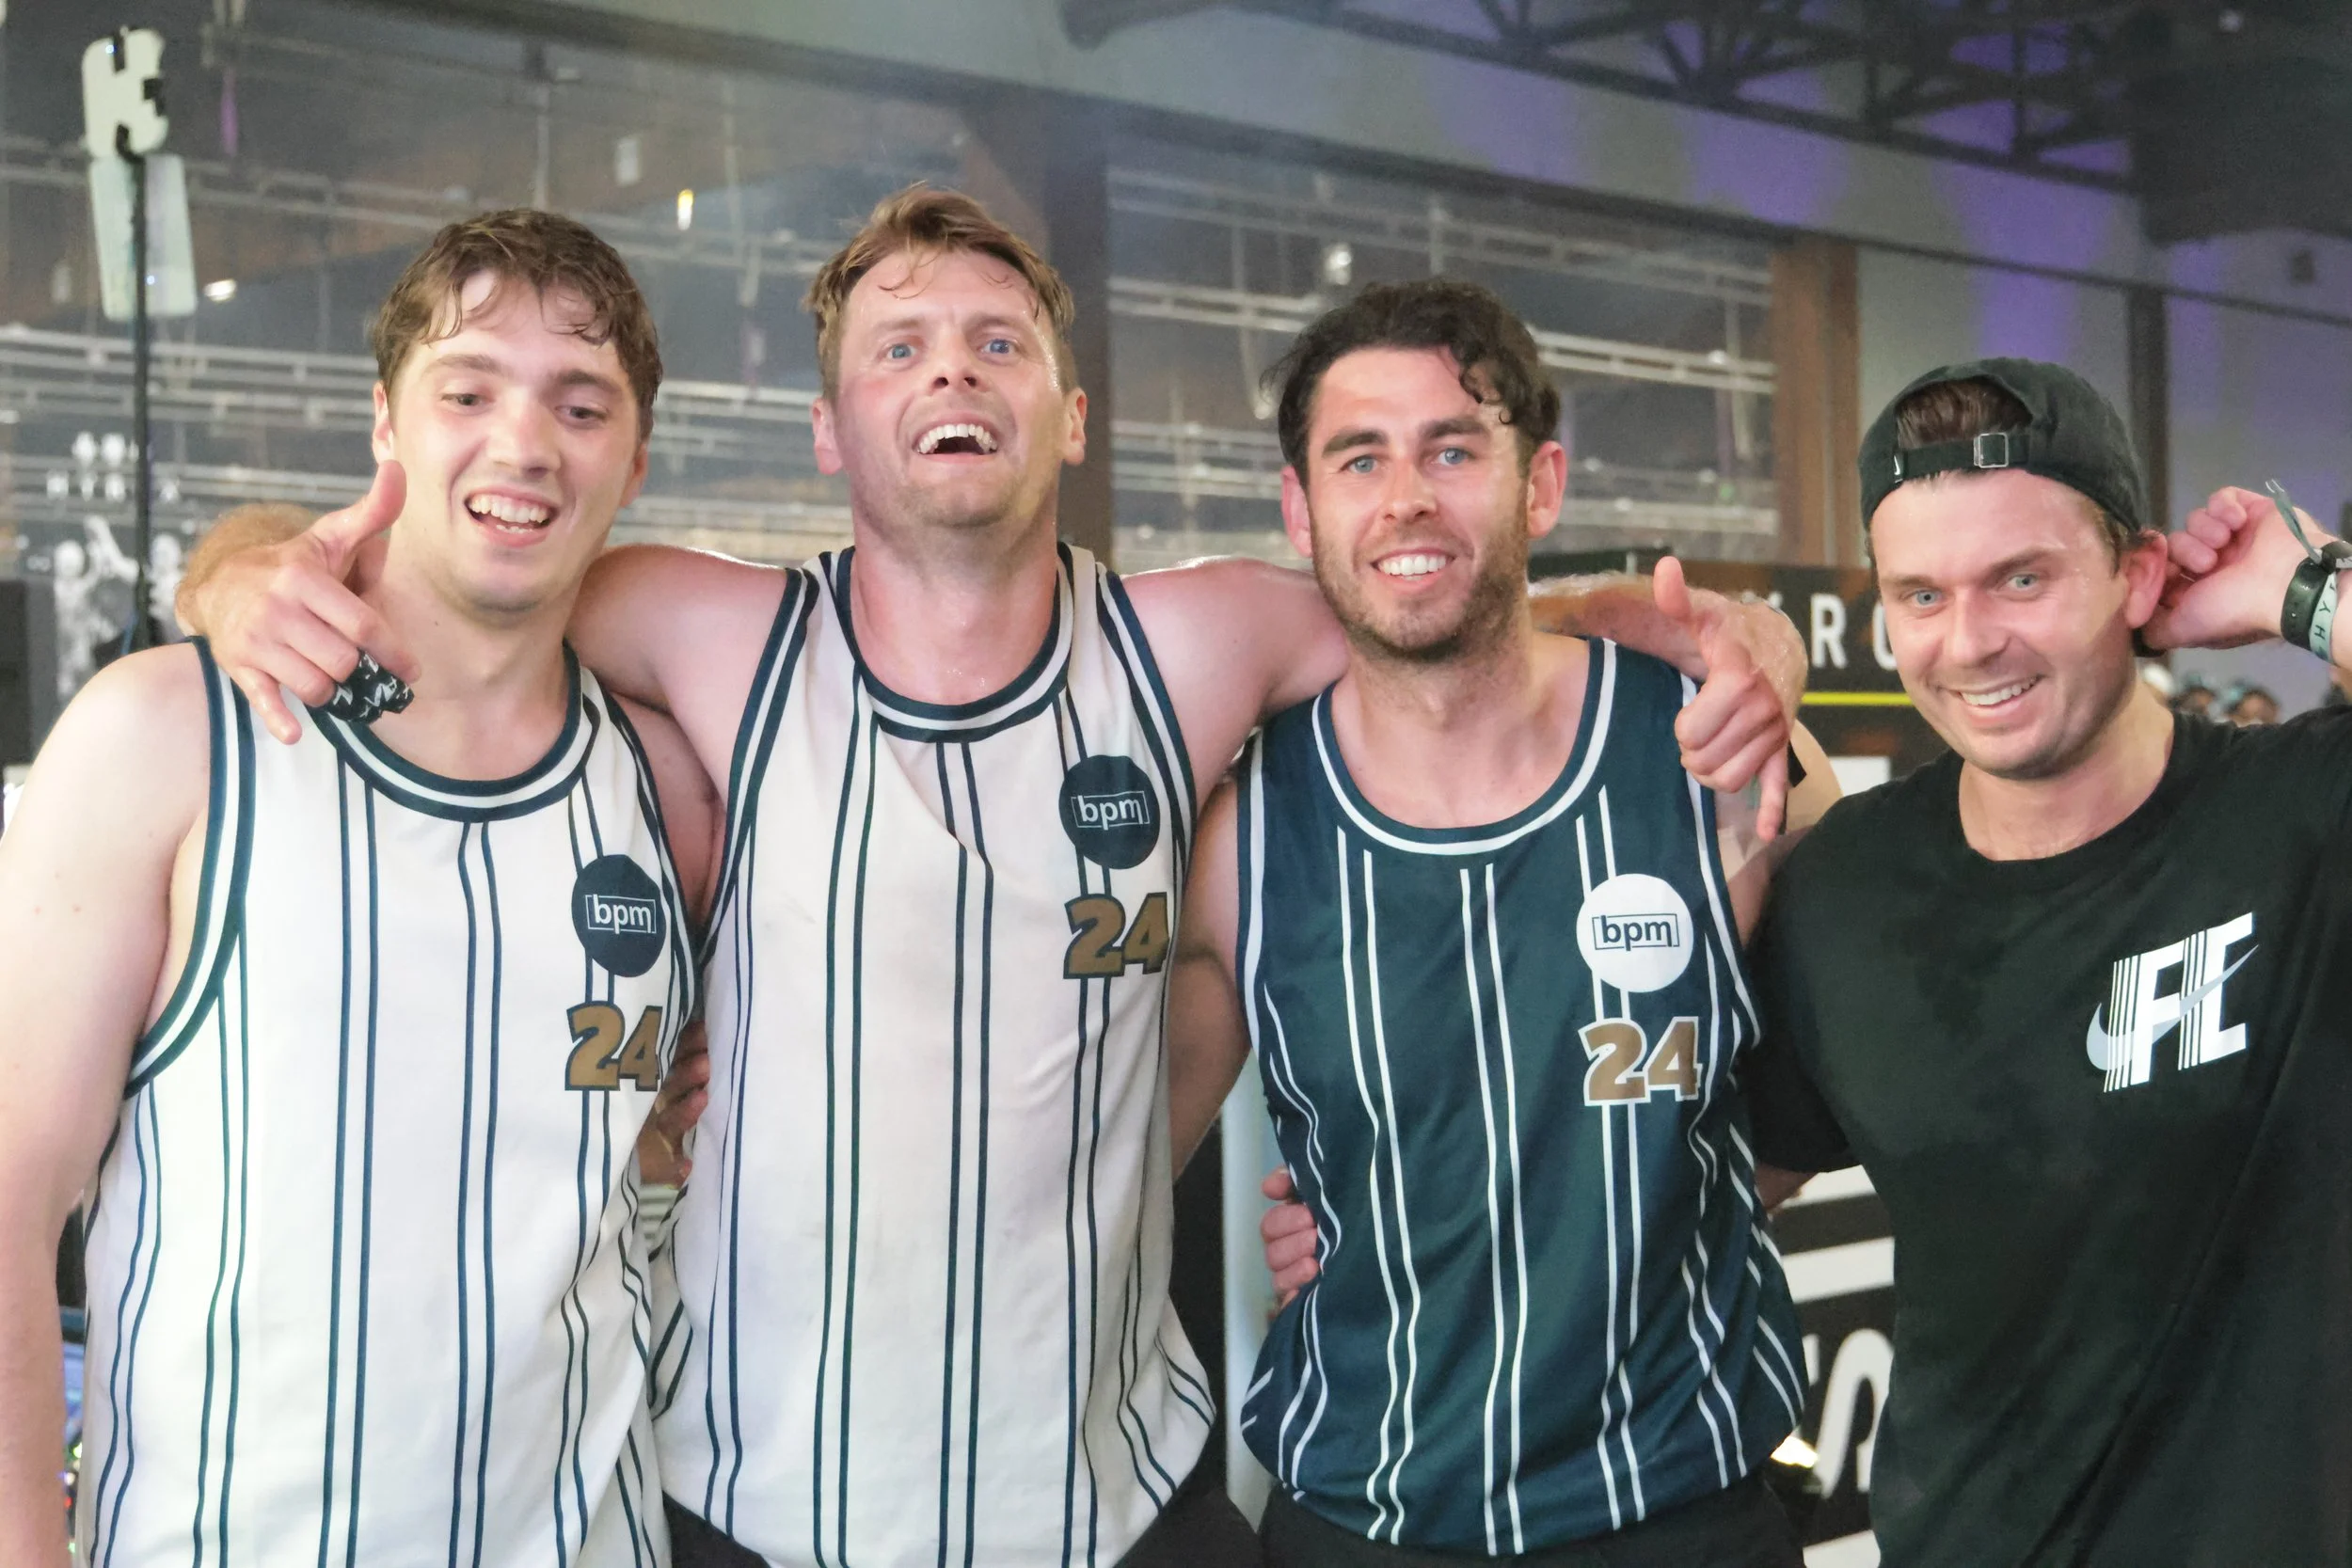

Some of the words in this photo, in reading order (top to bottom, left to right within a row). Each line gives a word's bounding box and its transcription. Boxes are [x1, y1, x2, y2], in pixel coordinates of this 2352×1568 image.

[1077, 795, 1144, 831] bpm
[593, 895, 652, 934] bpm
[1063, 892, 1169, 979] 24
[1601, 915, 1672, 951] bpm
[564, 1000, 663, 1091] 24
[1578, 1016, 1703, 1106] 24
